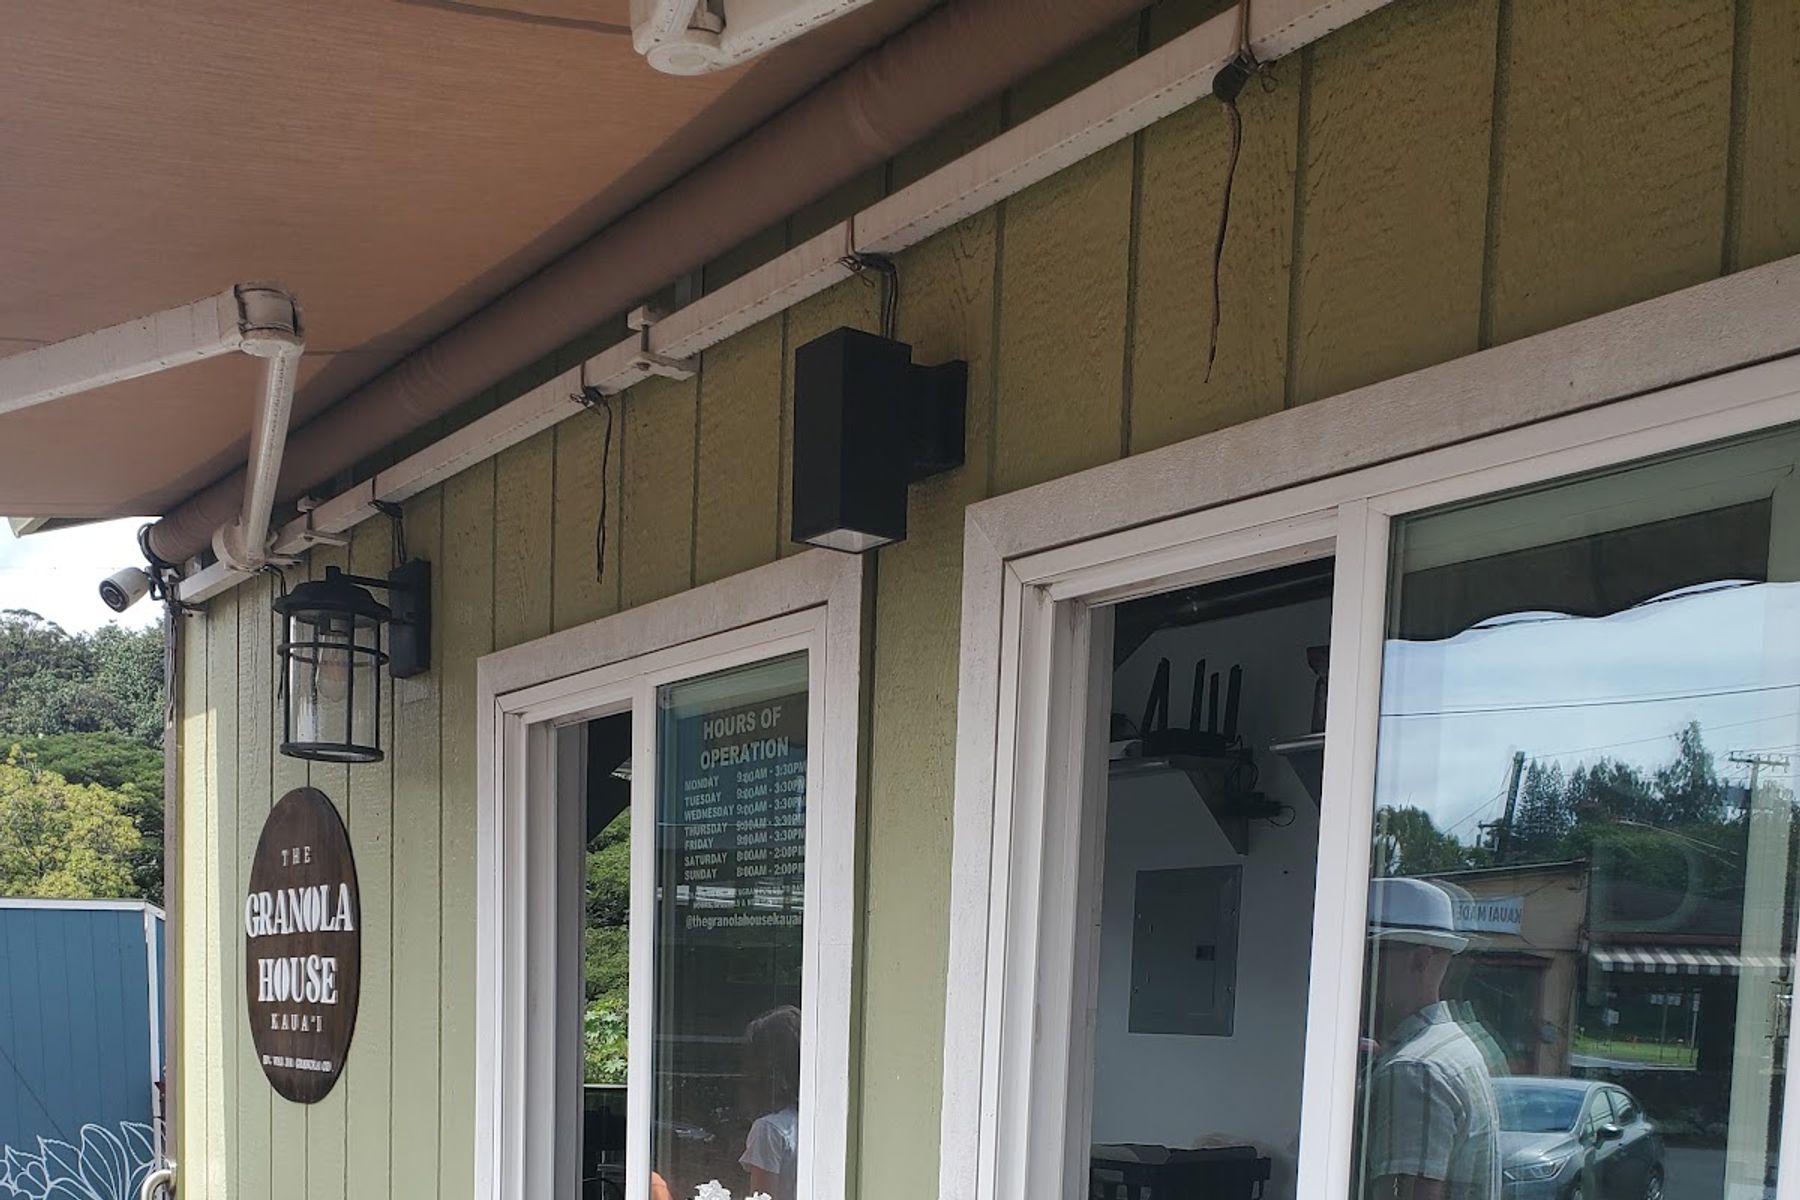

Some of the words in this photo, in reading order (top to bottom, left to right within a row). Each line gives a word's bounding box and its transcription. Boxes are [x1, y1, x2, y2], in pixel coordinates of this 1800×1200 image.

[703, 710, 756, 740] HOURS
[761, 705, 782, 729] OF
[700, 735, 789, 770] OPERATION
[684, 791, 721, 808] TUESDAY
[684, 804, 735, 822] WEDNESDAY
[684, 822, 728, 837] THURSDAY
[684, 838, 714, 851] FRIDAY
[281, 846, 311, 867] THE
[684, 852, 728, 867] SATURDAY
[684, 868, 718, 881] SUNDAY
[245, 882, 354, 938] GRANOLA
[258, 955, 338, 1005] HOUSE
